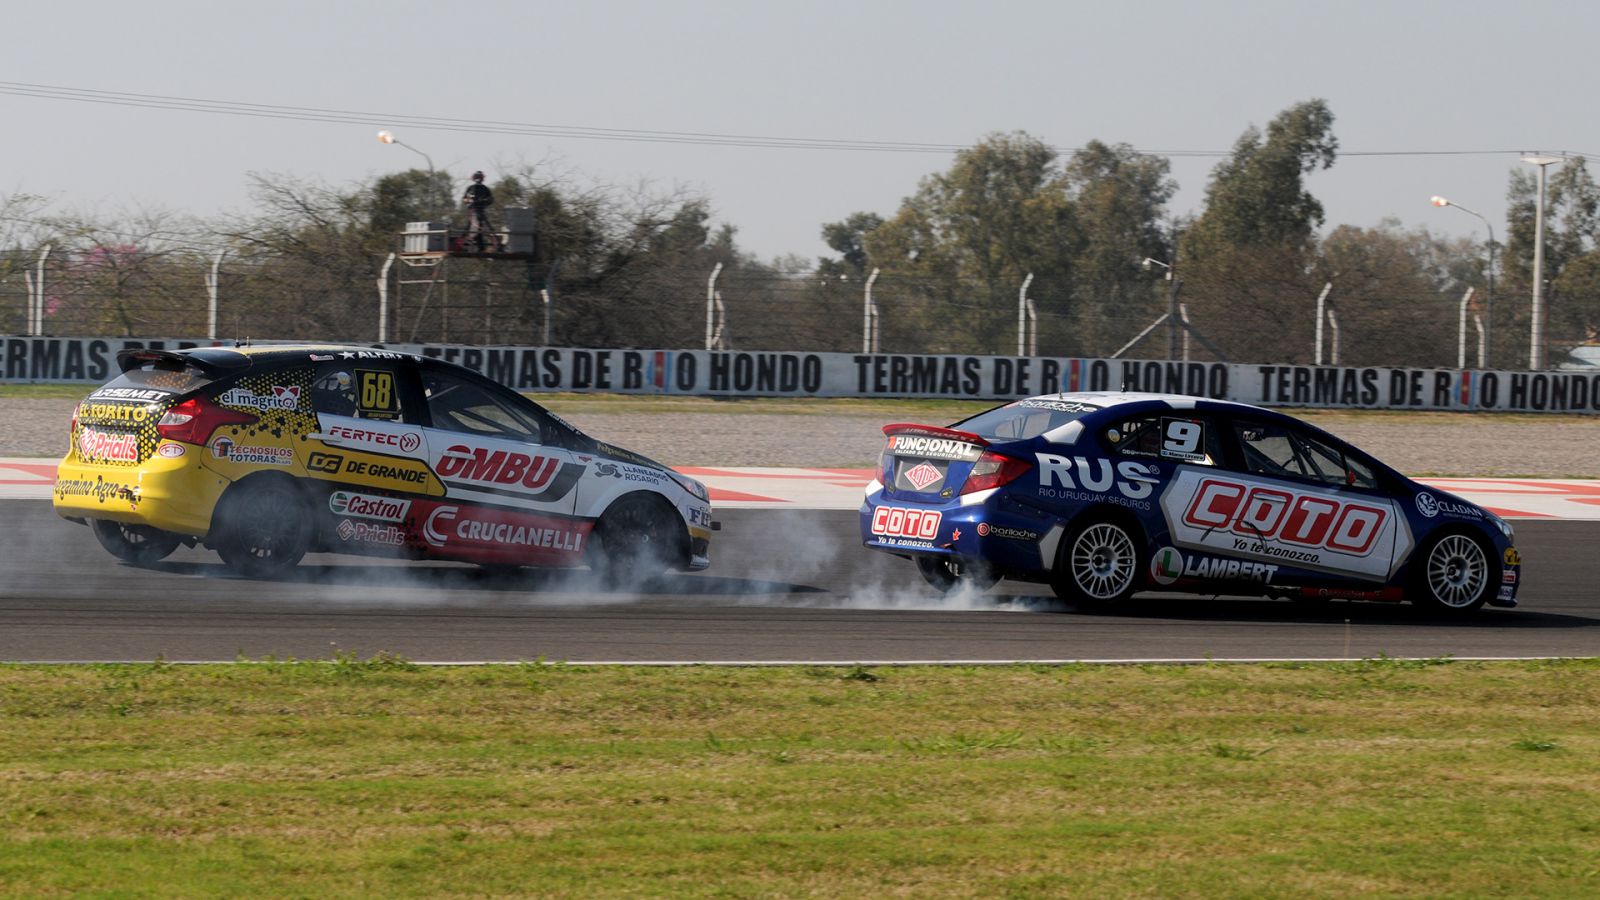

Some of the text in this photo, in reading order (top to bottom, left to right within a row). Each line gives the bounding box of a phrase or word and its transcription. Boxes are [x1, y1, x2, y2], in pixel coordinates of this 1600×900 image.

[571, 351, 611, 389] DE
[709, 352, 822, 393] HONDO
[854, 355, 981, 395] TERMAS
[993, 358, 1030, 396] DE
[1122, 361, 1229, 399] HONDO
[222, 391, 236, 404] el
[361, 371, 392, 410] 68
[1258, 366, 1379, 405] TERMAS
[1389, 367, 1423, 406] DE
[89, 404, 147, 422] TORITO
[92, 432, 138, 461] Prialis
[329, 426, 400, 446] FERTEC
[893, 436, 975, 456] FUNCIONAL
[1163, 421, 1201, 453] 9
[230, 445, 293, 457] TECNOSILOS
[230, 454, 276, 464] TOTORAS
[345, 460, 429, 484] DE GRANDE
[347, 495, 405, 519] Castrol
[1038, 487, 1151, 511] RIO URUGUAY SEGUROS
[872, 506, 941, 539] COTO
[1185, 480, 1387, 553] COTO
[355, 522, 405, 546] Prialis
[456, 519, 582, 552] CRUCIANELLI
[878, 536, 887, 544] Yo
[990, 524, 1038, 539] bariloche
[1232, 538, 1321, 564] Yo te conozco.
[1183, 555, 1279, 585] LAMBERT
